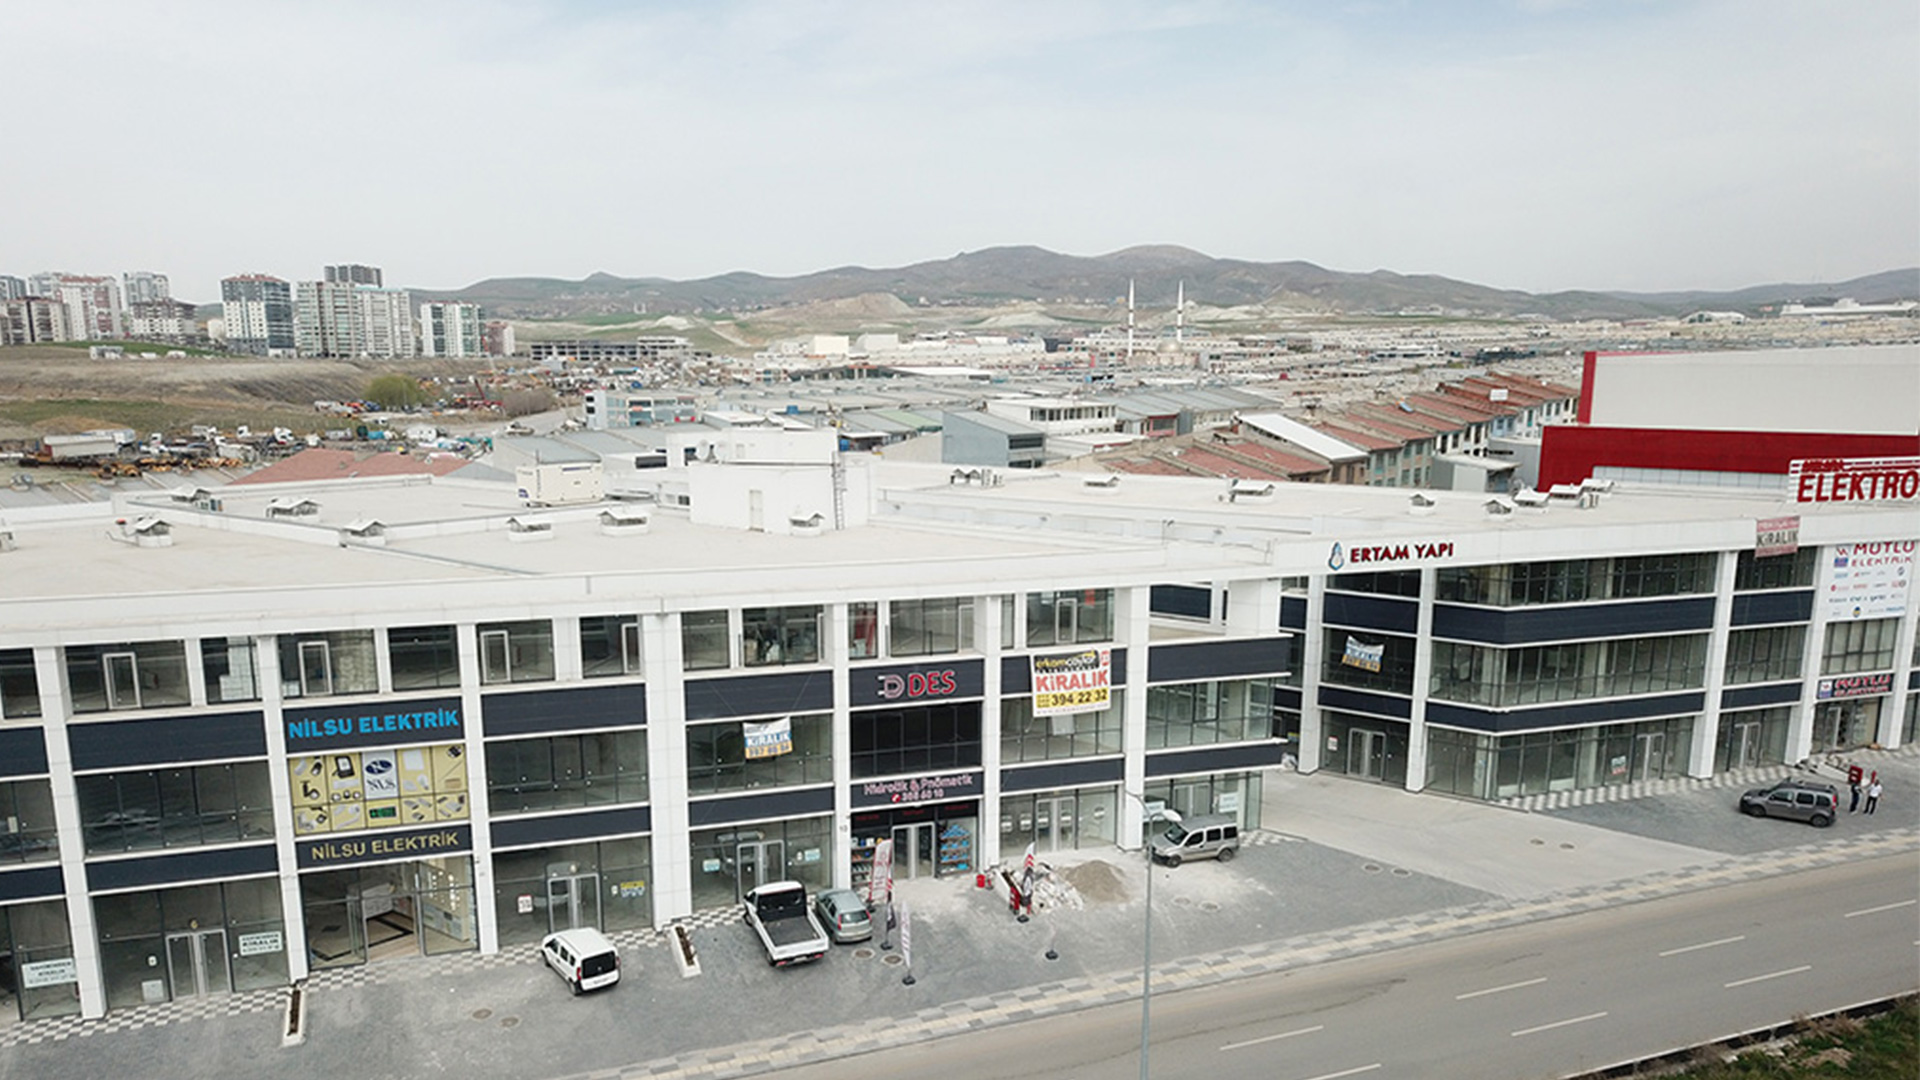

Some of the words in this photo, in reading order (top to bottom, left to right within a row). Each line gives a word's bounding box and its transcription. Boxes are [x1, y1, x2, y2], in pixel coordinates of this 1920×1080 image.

[1797, 470, 1919, 502] ELEKTRO
[1350, 545, 1410, 563] ERTAM
[1414, 542, 1454, 558] YAPI
[908, 670, 956, 697] DES
[1835, 674, 1891, 688] MUTLU
[1052, 694, 1074, 706] 394
[1078, 691, 1092, 703] 22
[1095, 689, 1108, 701] 32
[288, 718, 353, 738] NİLSU
[359, 708, 459, 733] ELEKTRİK
[366, 778, 396, 792] NLS
[311, 843, 366, 861] NİLSU
[372, 831, 459, 855] ELEKTRİK
